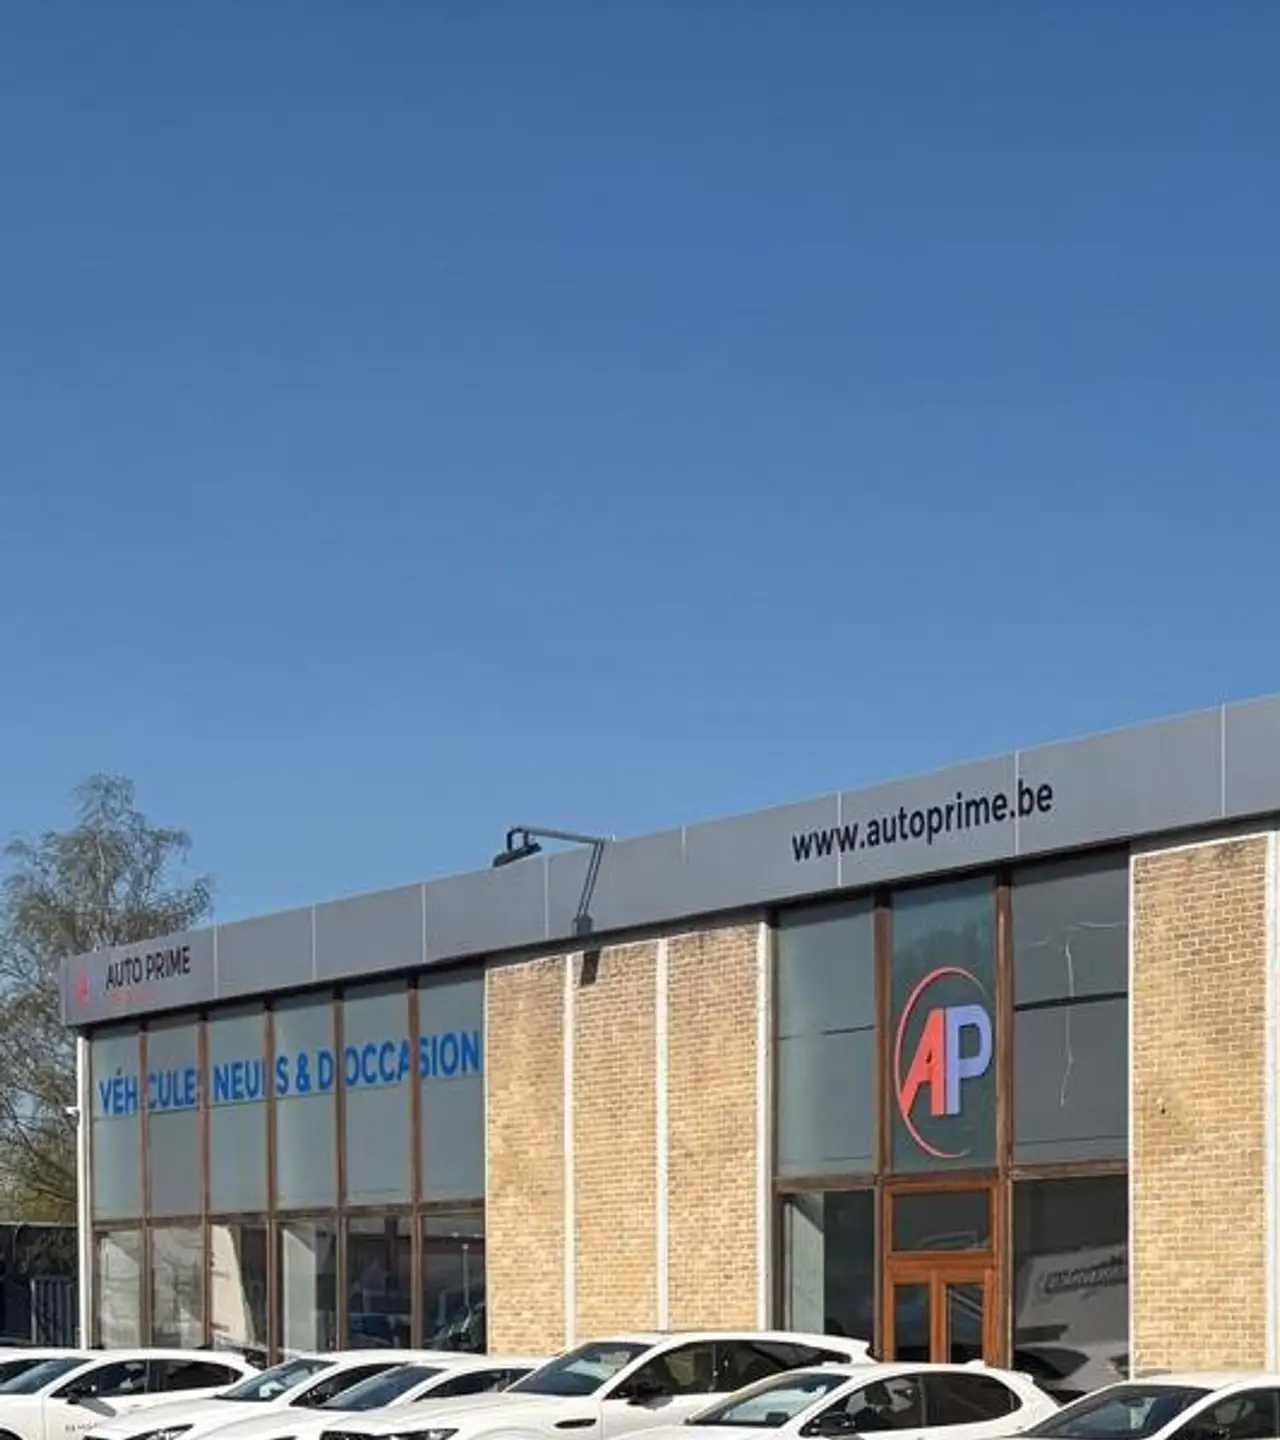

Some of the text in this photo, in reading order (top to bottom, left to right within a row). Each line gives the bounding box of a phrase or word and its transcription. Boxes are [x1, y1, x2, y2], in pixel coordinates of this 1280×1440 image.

[792, 778, 1054, 861] www.autoprime.be
[105, 956, 142, 991] AUTO
[146, 946, 191, 980] PRIME
[99, 1029, 479, 1116] VÉHCULE NEUS & DOCCASION
